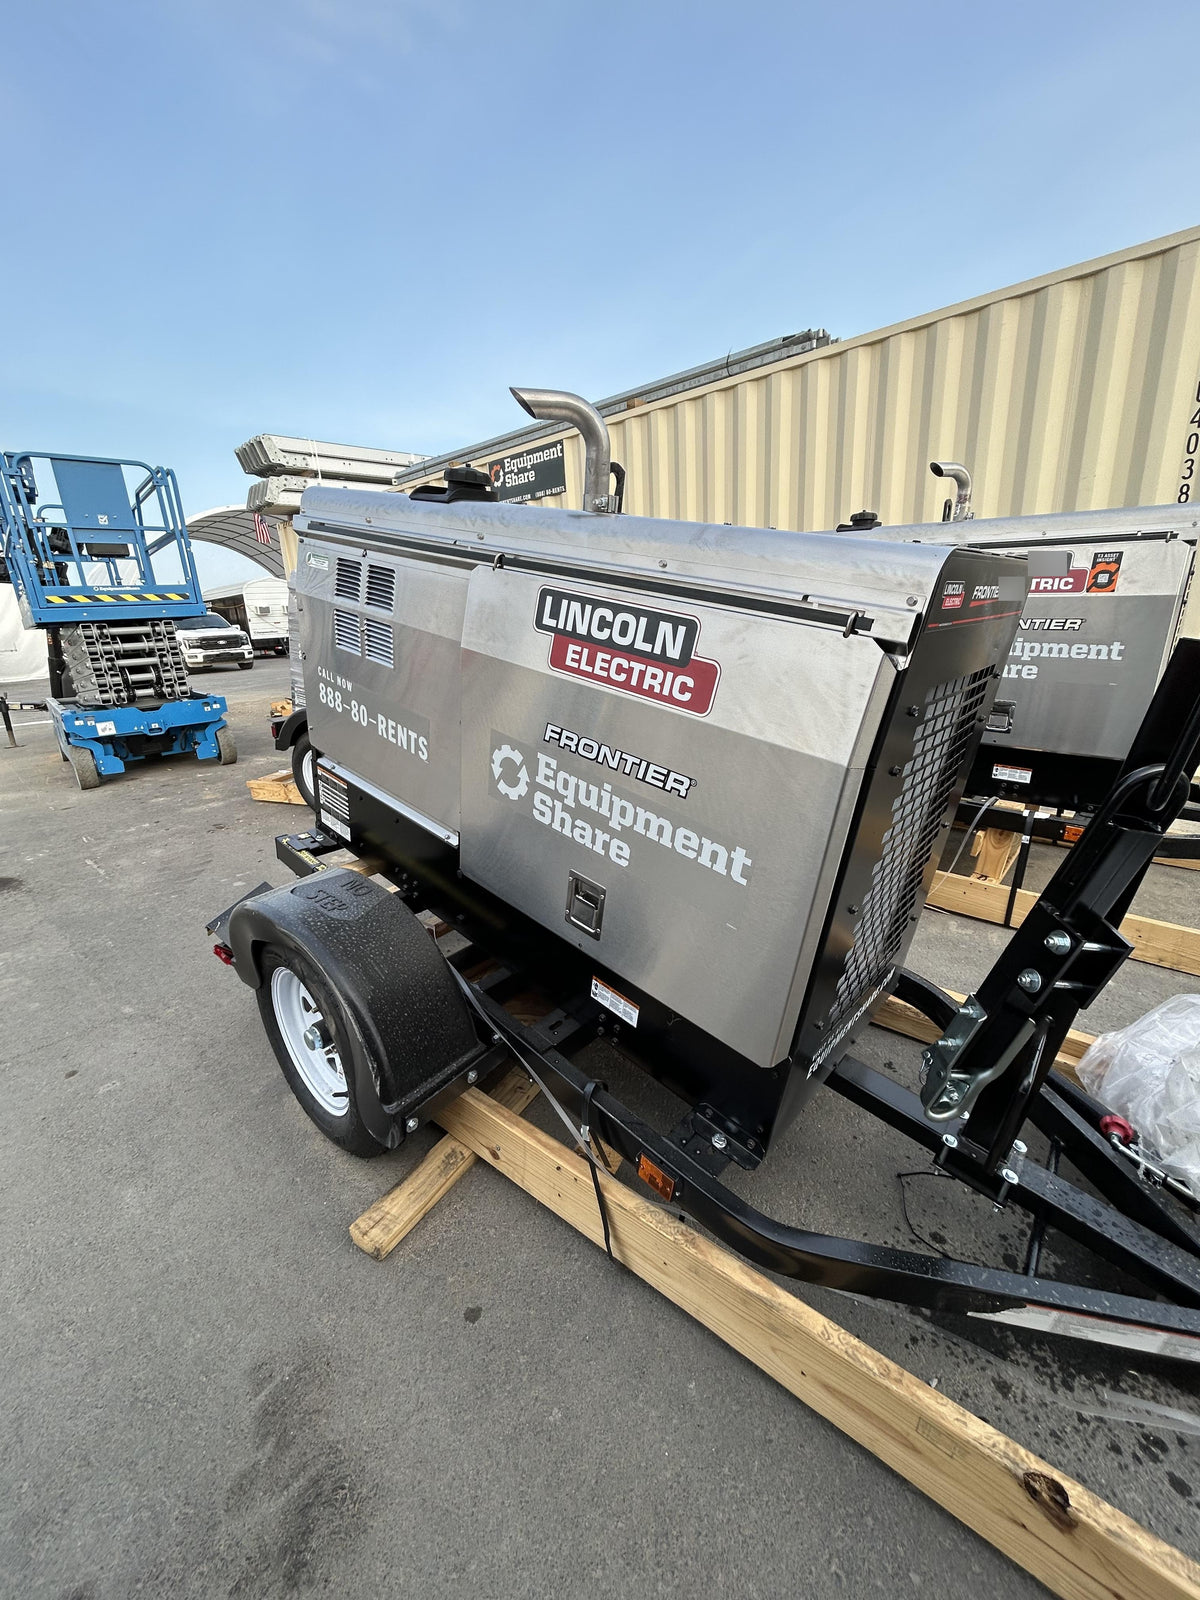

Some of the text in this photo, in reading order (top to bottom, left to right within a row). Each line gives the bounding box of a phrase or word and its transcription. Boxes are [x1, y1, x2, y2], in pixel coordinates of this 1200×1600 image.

[504, 443, 563, 472] Equipment
[505, 469, 536, 487] Share
[943, 583, 964, 595] LINCOLN
[971, 585, 1000, 600] FRONTIE
[1030, 577, 1074, 590] TRIC
[542, 595, 687, 660] LINCOLN
[1018, 618, 1083, 631] NTIER
[1009, 637, 1125, 661] ipment
[317, 666, 353, 692] CALL NOW
[564, 643, 695, 702] ELECTRIC
[319, 682, 428, 761] 888-80-RENTS
[532, 790, 631, 868] Share
[535, 751, 752, 887] Equipment
[340, 879, 375, 897] NO
[306, 889, 349, 912] STEP
